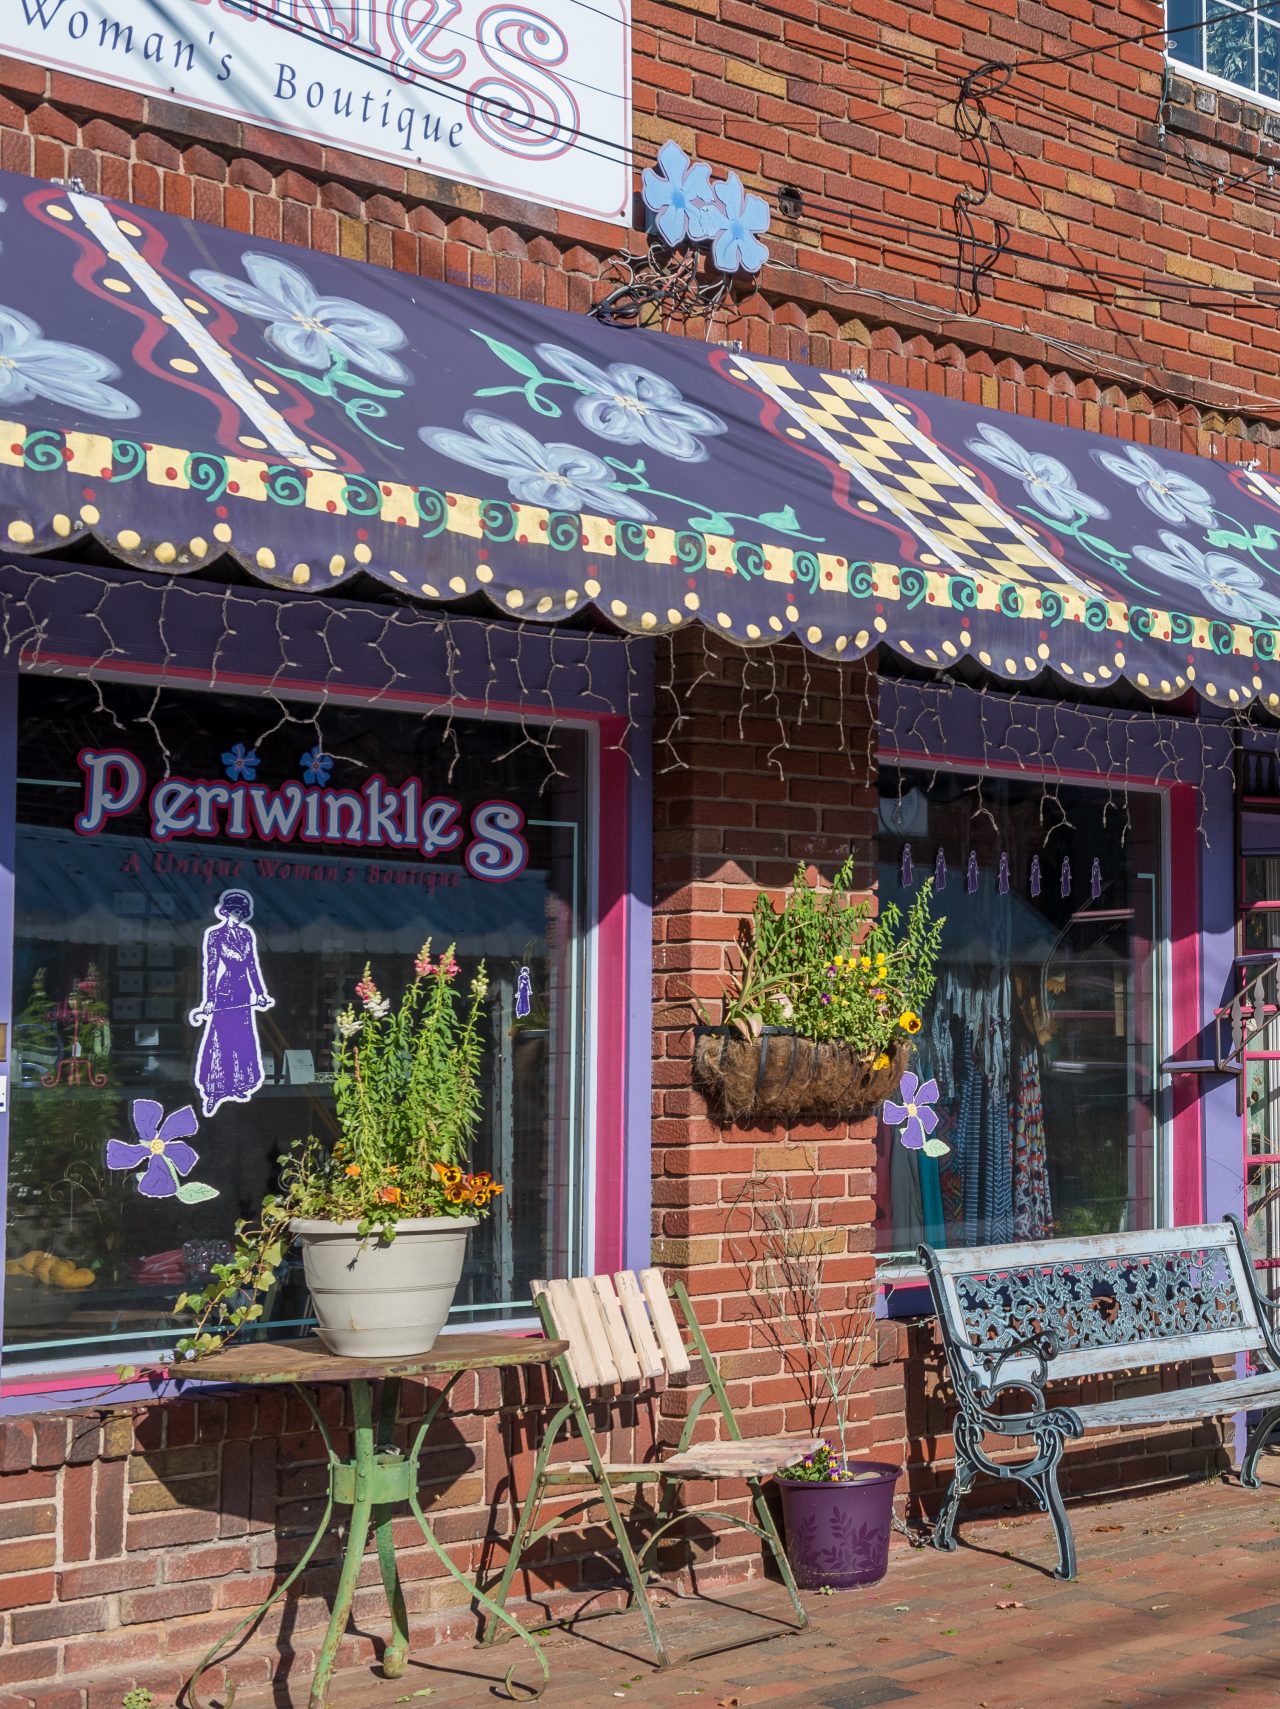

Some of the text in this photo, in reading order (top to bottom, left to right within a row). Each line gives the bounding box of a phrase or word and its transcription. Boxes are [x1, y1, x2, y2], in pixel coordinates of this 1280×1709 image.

[21, 0, 463, 151] Woman's Boutique
[75, 747, 529, 882] PeriwinkleS
[121, 852, 463, 897] A Unique Woman's Boutique
